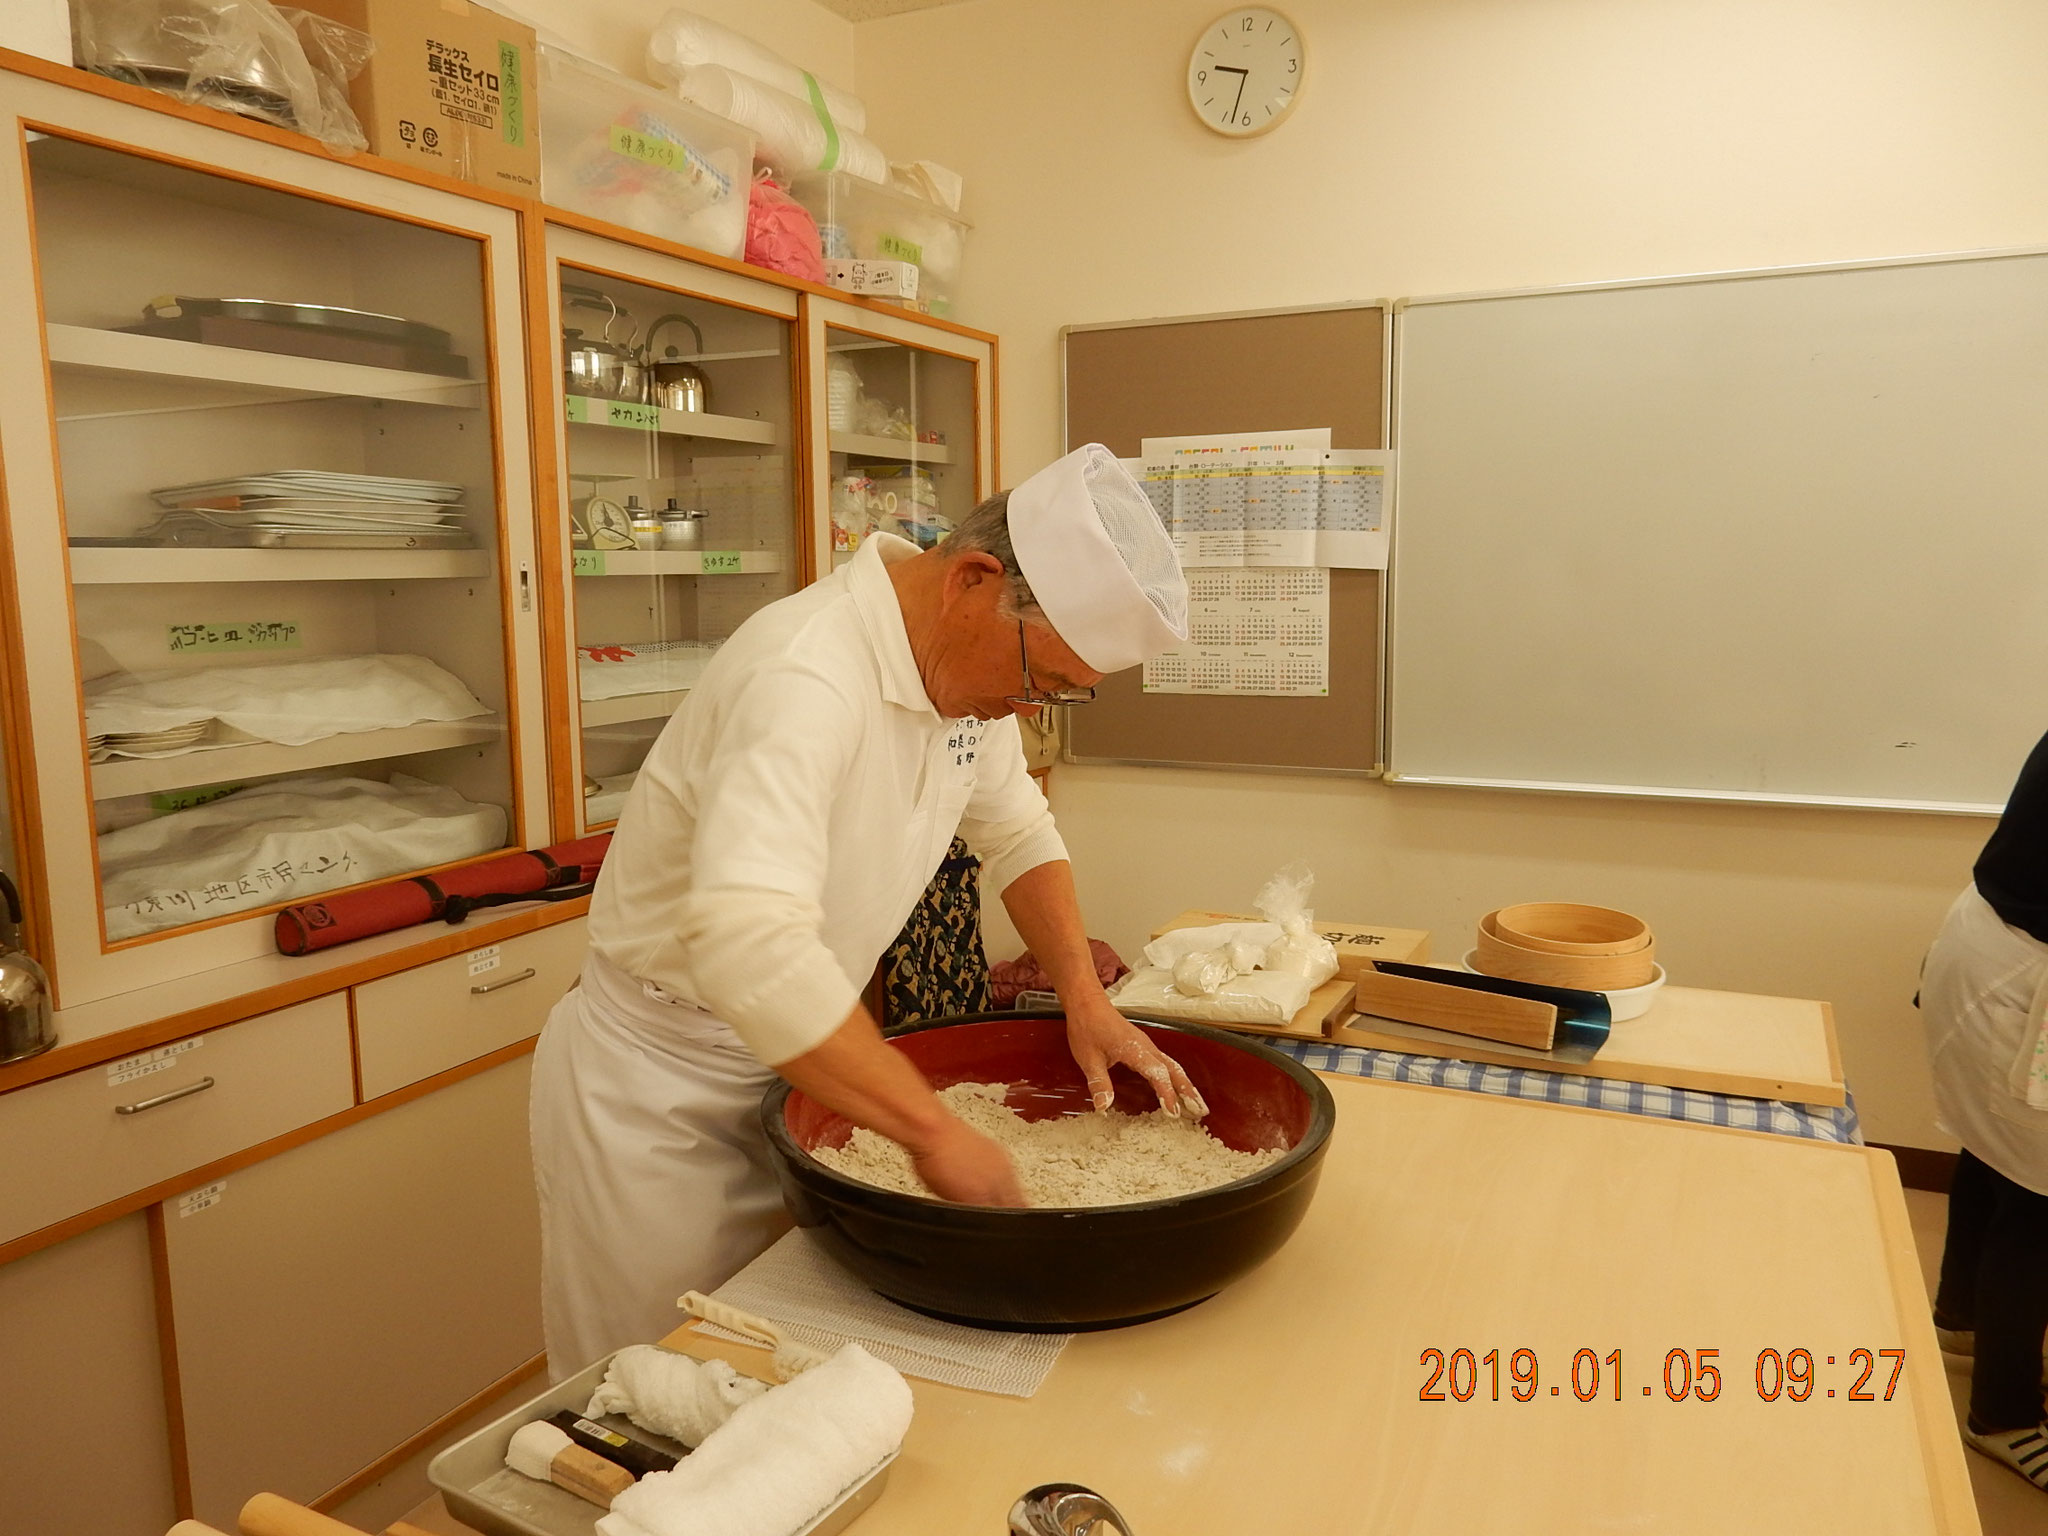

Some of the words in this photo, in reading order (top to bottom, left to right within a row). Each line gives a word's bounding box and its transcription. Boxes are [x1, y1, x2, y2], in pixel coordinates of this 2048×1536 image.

[1242, 18, 1254, 32] 12
[426, 39, 470, 63] デラックス
[428, 53, 500, 92] 長生セイロ
[1288, 59, 1297, 73] 3
[1198, 71, 1207, 86] 9
[1242, 112, 1251, 126] 6
[620, 134, 674, 166] 健康づくり
[517, 176, 532, 186] China
[948, 733, 983, 752] 和楽の
